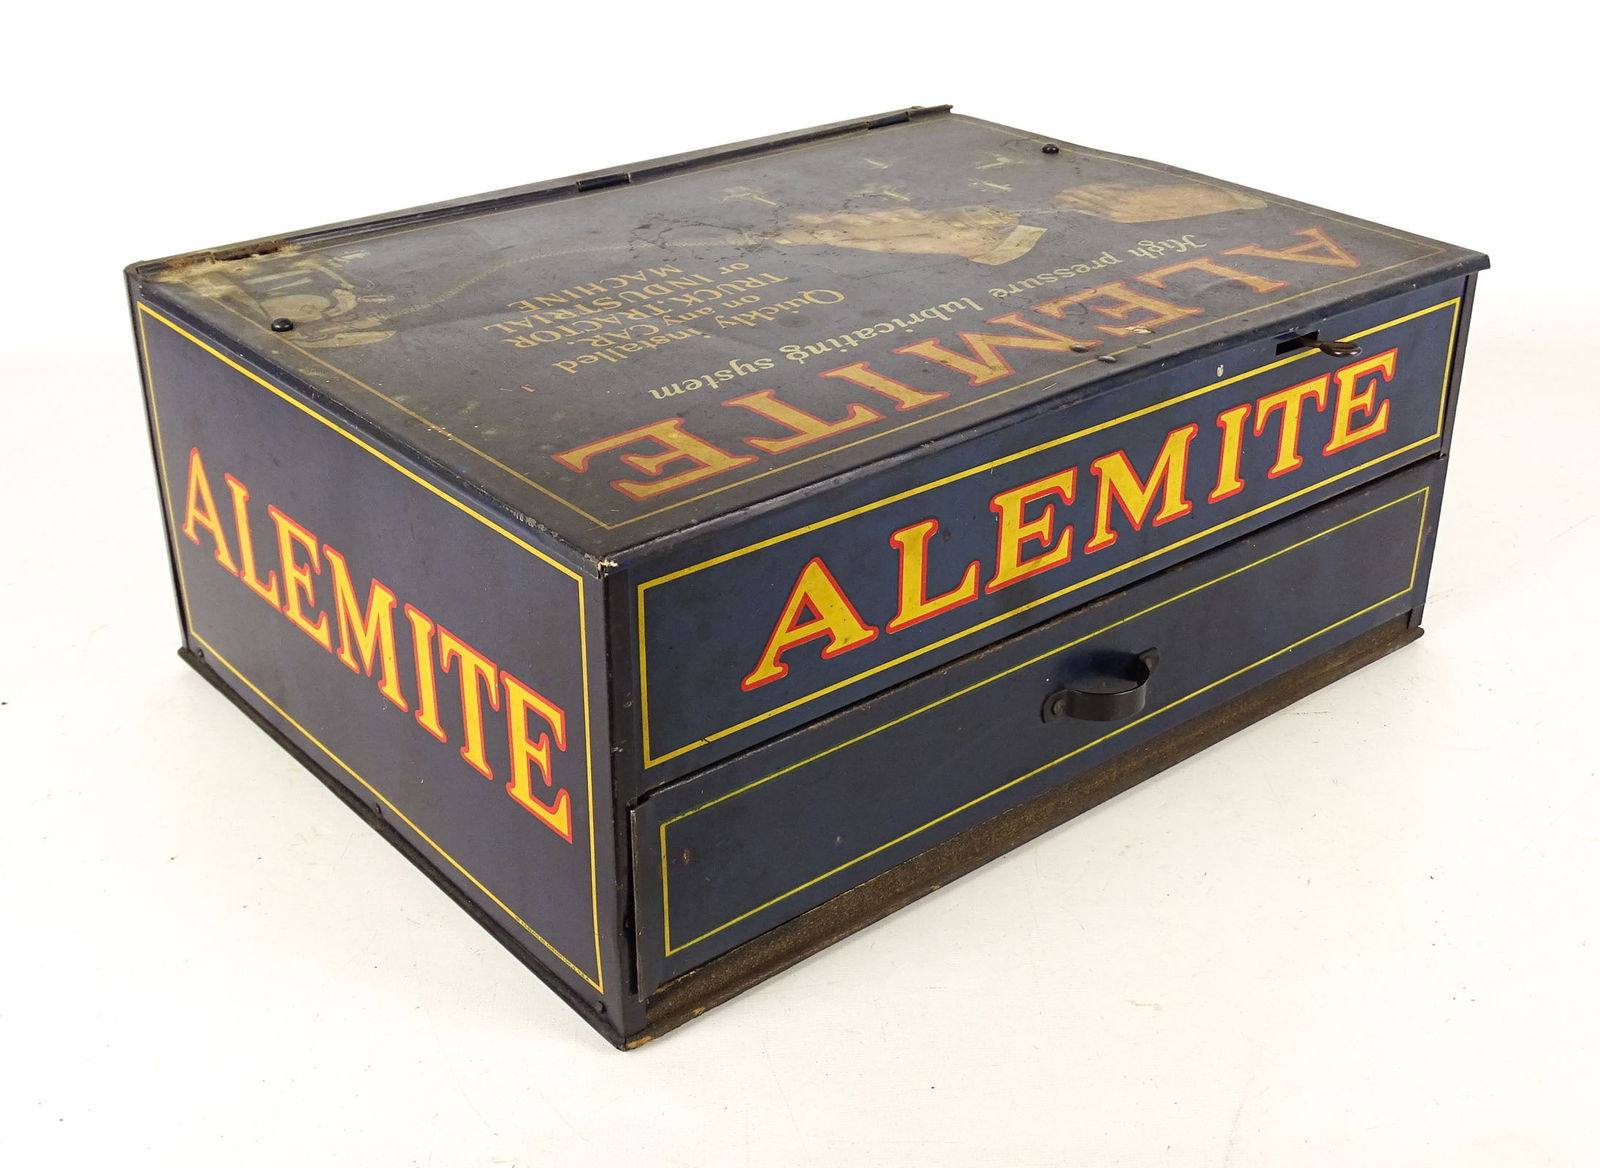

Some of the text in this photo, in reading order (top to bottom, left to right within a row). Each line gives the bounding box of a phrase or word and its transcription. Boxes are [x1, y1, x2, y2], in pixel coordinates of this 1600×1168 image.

[482, 262, 750, 333] or INDUSTRIAL
[507, 264, 683, 313] MACHINE
[648, 234, 1208, 400] High pressure lubricating system
[662, 306, 716, 326] any
[720, 295, 761, 309] on
[550, 226, 1363, 501] ALEMITE
[552, 289, 845, 373] Quickly installed
[741, 347, 1397, 691] ALEMITE
[182, 447, 572, 844] ALEMITE
